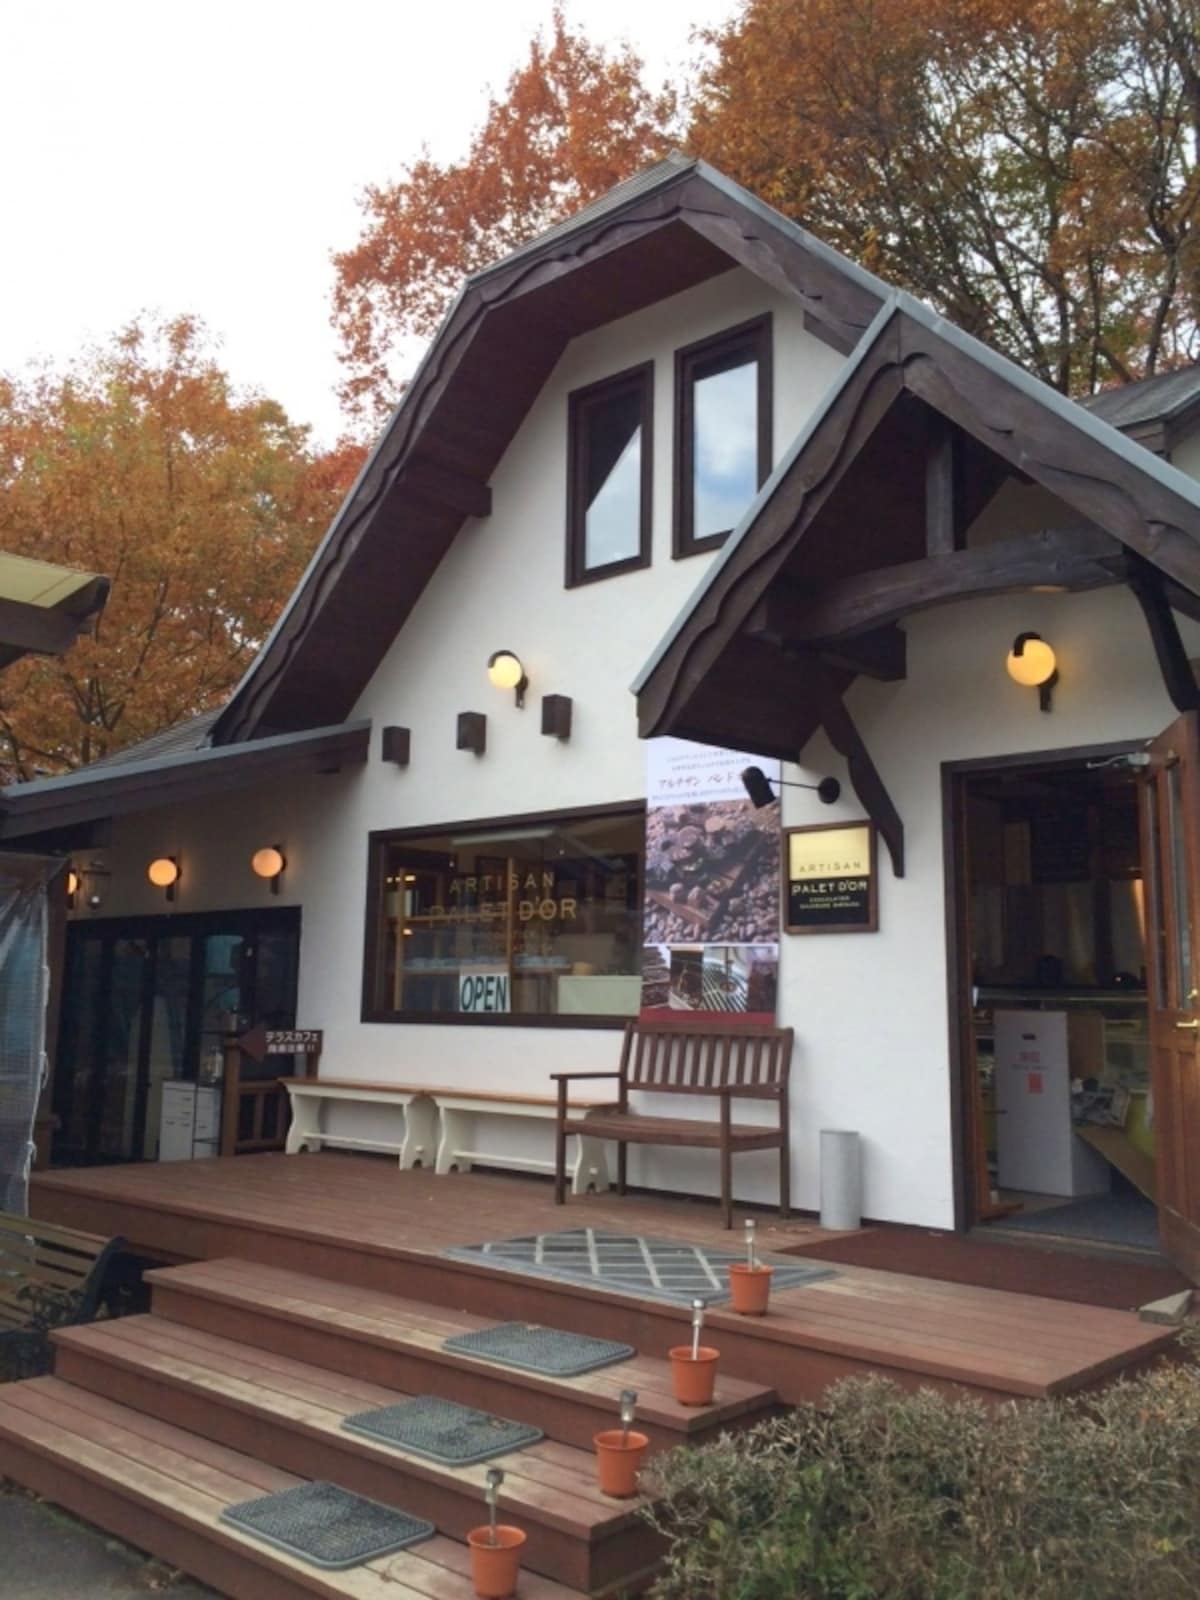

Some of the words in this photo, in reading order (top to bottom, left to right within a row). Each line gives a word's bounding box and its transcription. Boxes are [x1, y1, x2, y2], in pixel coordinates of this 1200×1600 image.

[799, 861, 862, 873] ARTISAN
[449, 872, 555, 894] ARTISAN
[791, 882, 835, 896] PALET
[519, 897, 577, 921] D'OR
[461, 976, 507, 1011] OPEN
[265, 1031, 319, 1042] テラスカフェ
